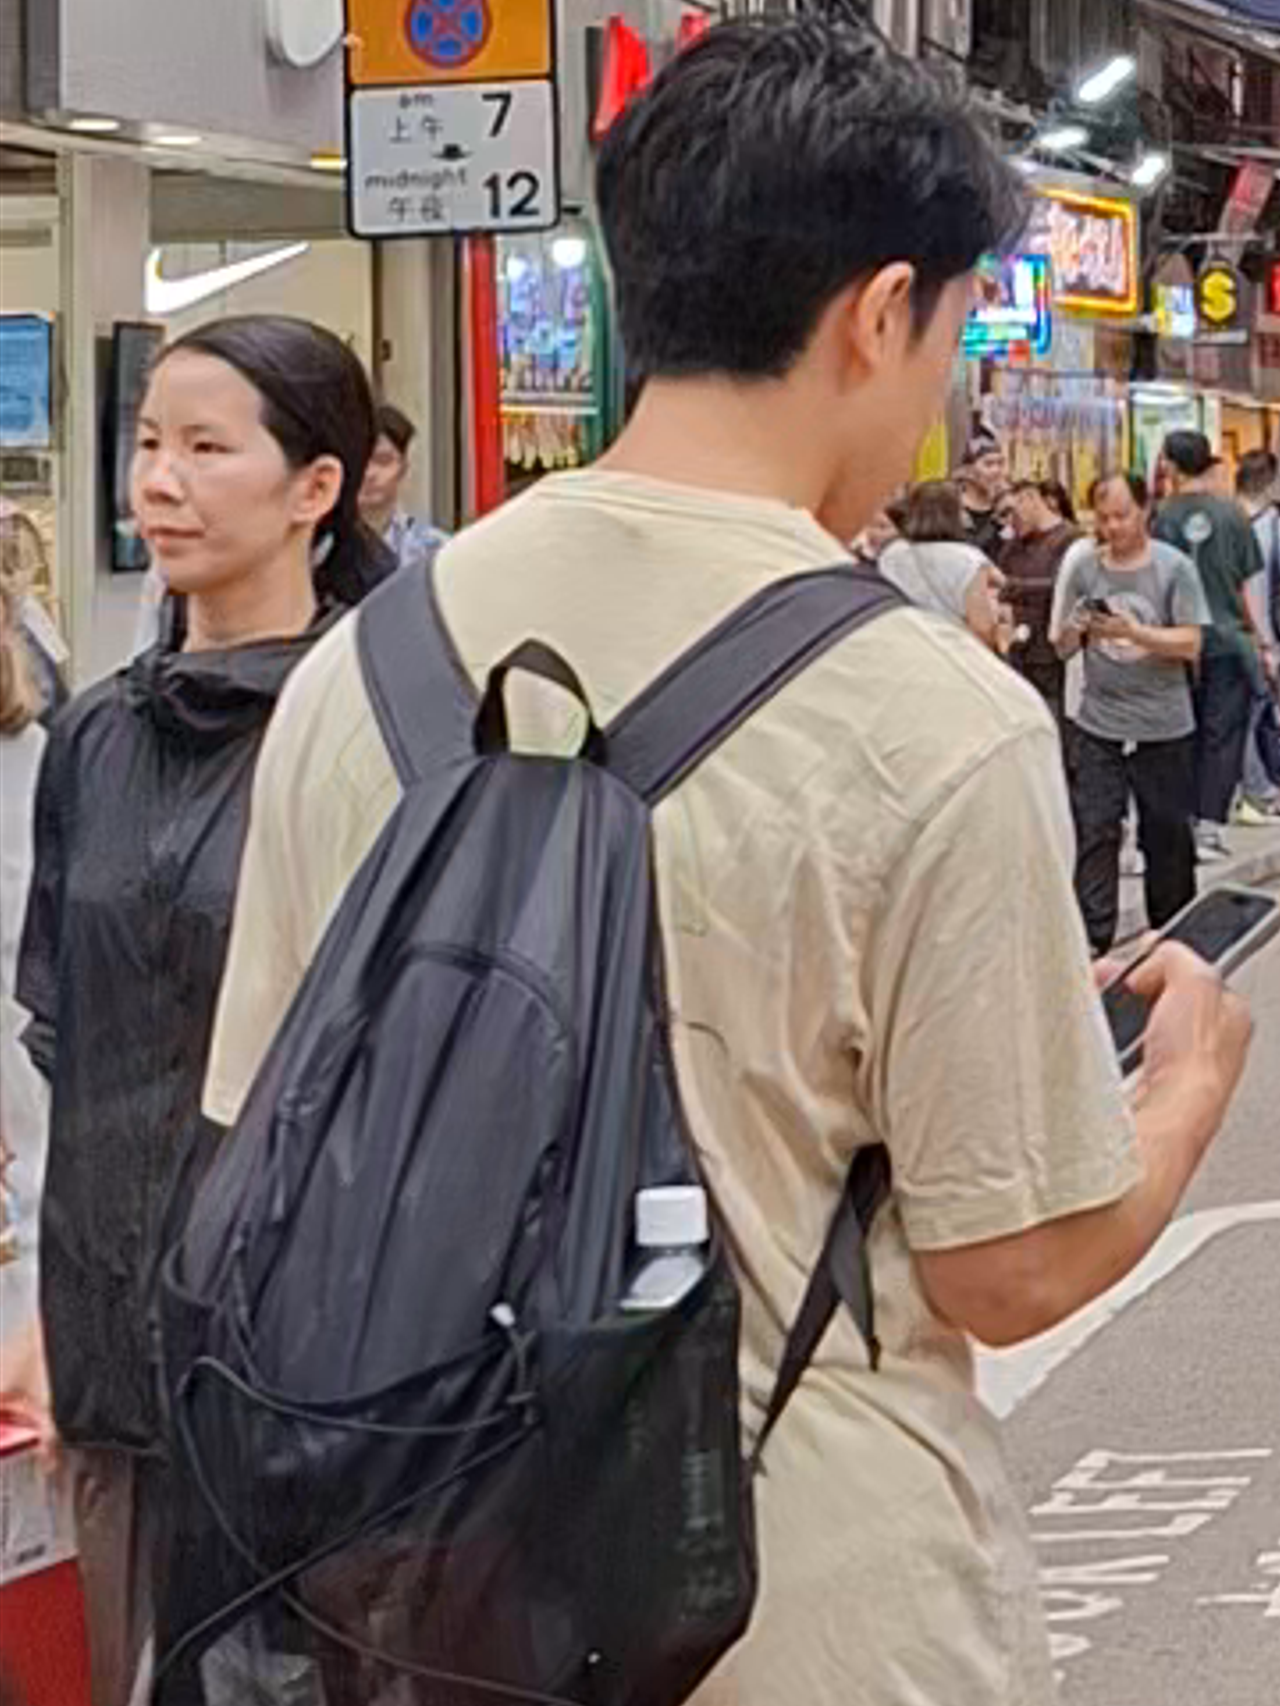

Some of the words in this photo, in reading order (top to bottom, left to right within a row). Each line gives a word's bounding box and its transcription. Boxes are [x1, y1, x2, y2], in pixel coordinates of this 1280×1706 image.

[389, 116, 444, 143] 上午
[481, 91, 512, 137] 7
[364, 168, 467, 190] midnight
[482, 171, 541, 219] 12
[1029, 1447, 1273, 1541] LEFT
